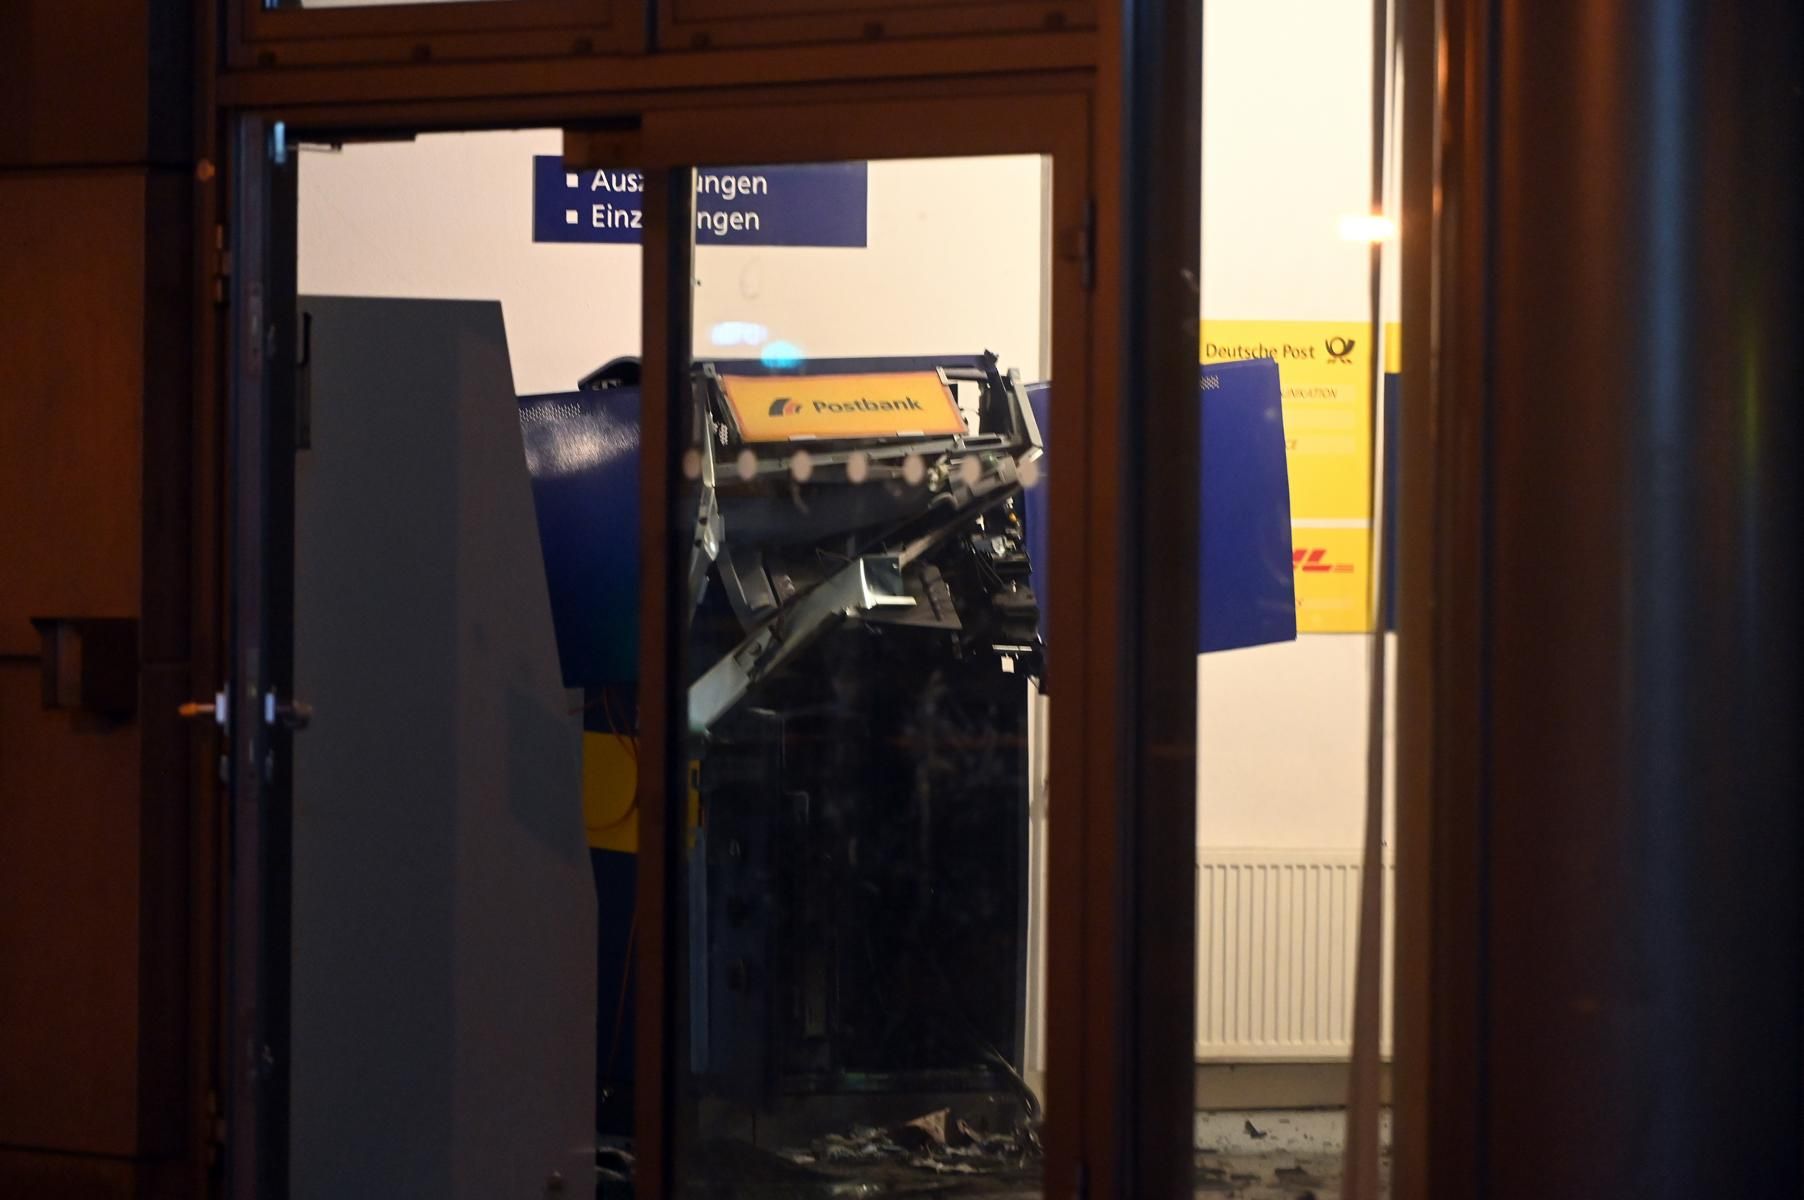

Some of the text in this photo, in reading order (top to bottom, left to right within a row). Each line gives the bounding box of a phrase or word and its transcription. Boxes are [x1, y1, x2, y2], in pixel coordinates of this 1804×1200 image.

[591, 169, 767, 200] Ausngen
[592, 203, 759, 236] Einzngen
[1206, 342, 1316, 359] Deutsche Post
[813, 396, 922, 415] Postbank
